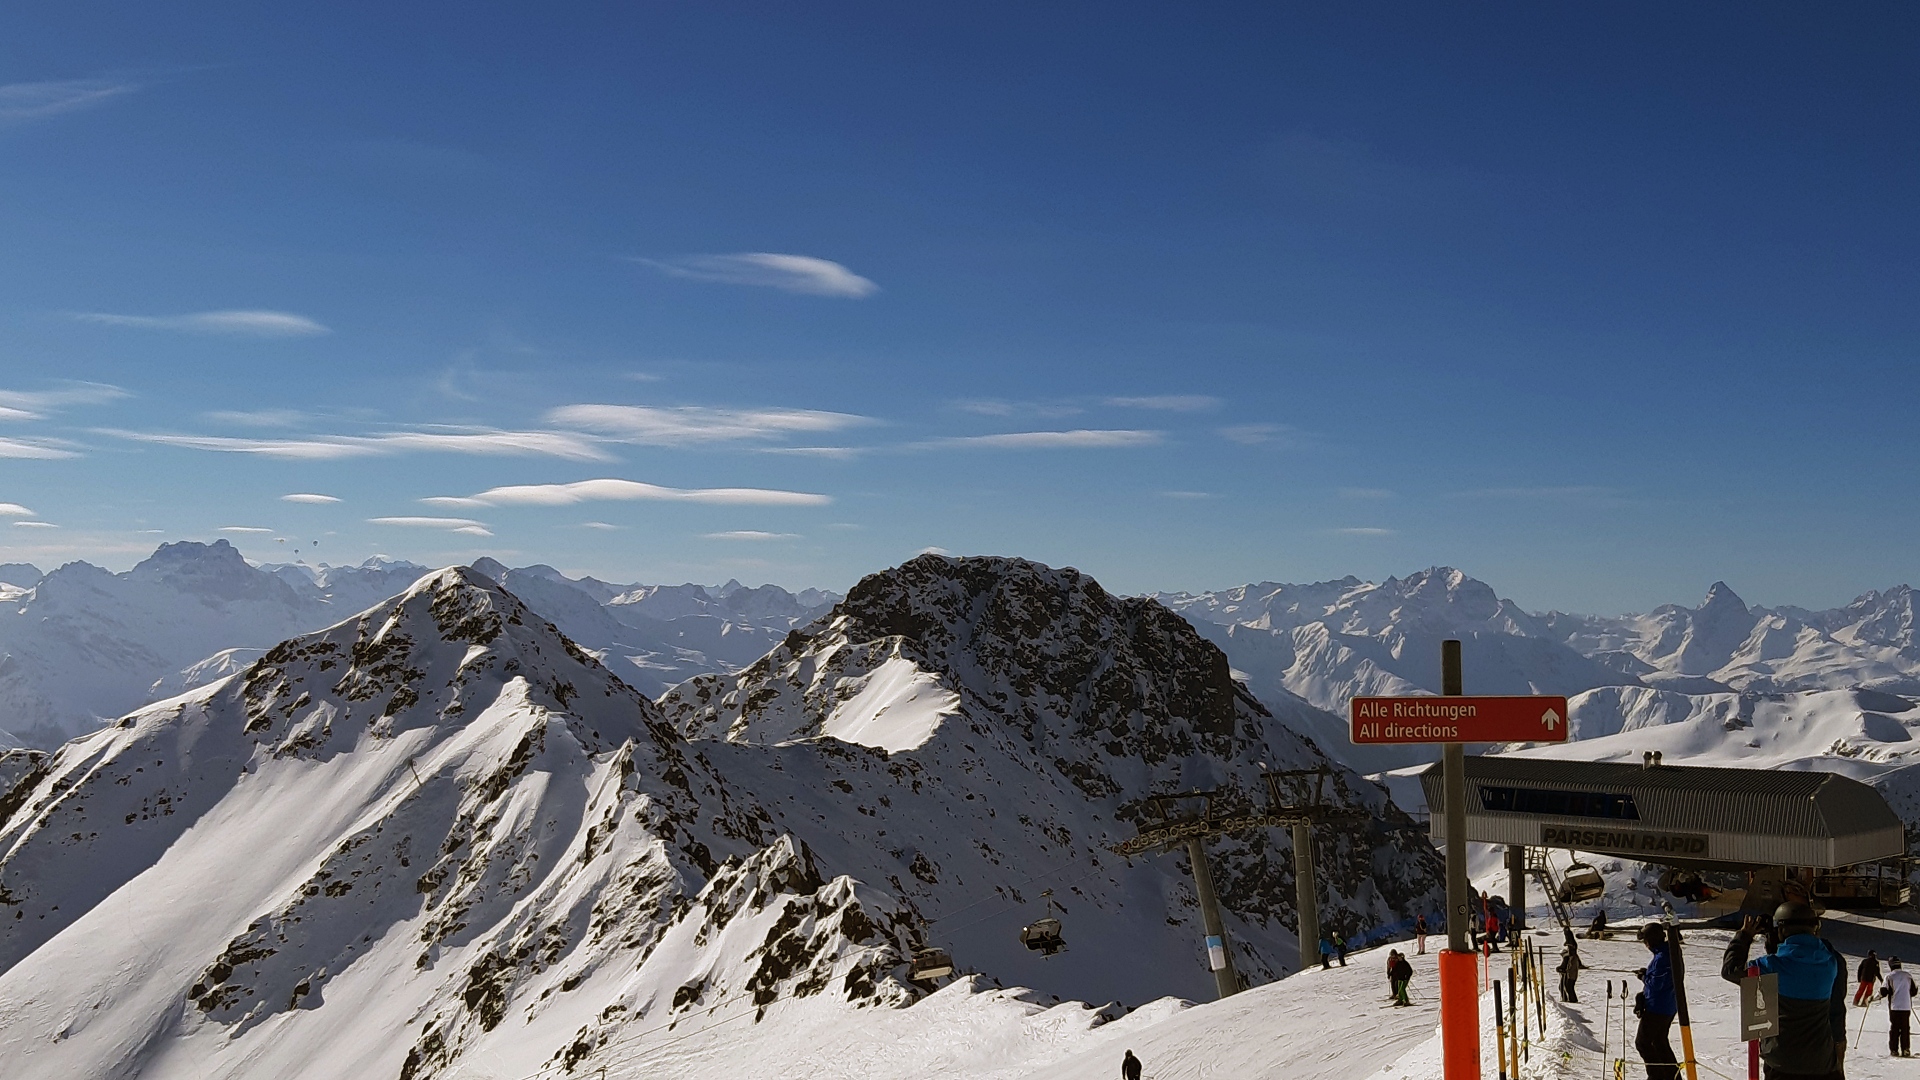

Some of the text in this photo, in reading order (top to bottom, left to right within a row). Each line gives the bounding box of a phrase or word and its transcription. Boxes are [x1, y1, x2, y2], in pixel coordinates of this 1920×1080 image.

[1359, 702, 1477, 721] Alle Richtungen
[1359, 723, 1458, 738] All directions
[1543, 828, 1705, 853] PARSENN RAPID
